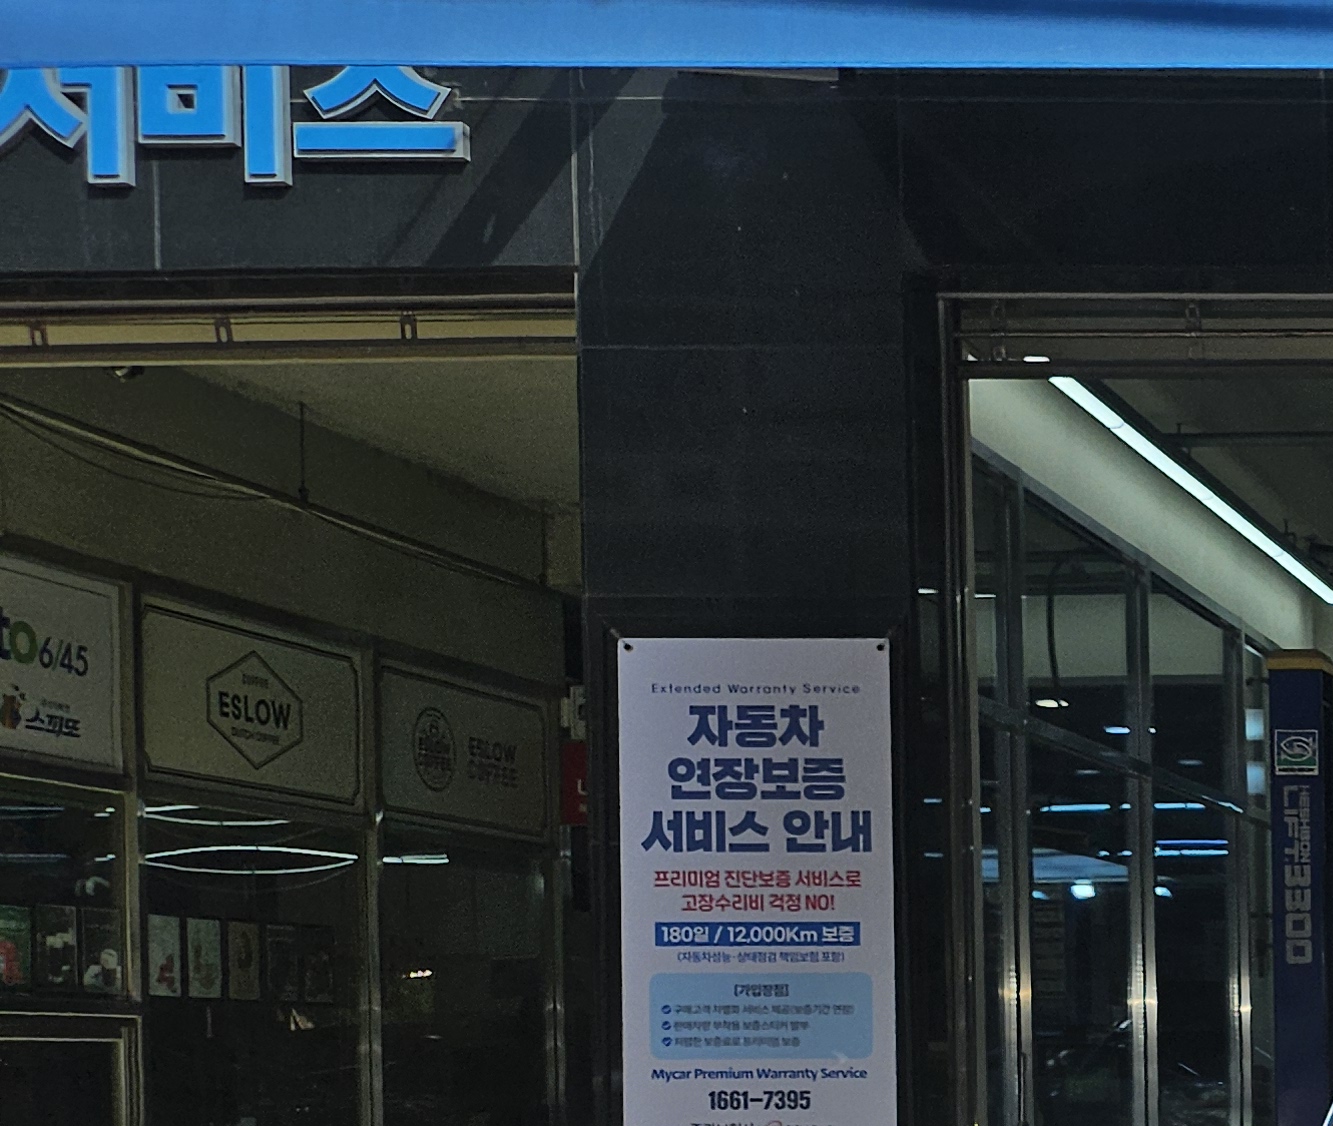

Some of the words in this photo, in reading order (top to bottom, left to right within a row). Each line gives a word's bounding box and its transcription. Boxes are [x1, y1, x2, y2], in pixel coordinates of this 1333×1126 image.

[652, 684, 721, 693] Extended
[728, 684, 796, 695] Warranty
[803, 683, 860, 694] Service
[218, 691, 291, 730] ESLOW
[687, 704, 824, 747] 자동차
[668, 757, 846, 800] 연장보증
[641, 810, 770, 852] 서비스
[783, 810, 872, 853] 안내
[654, 870, 720, 888] 프리미엄
[725, 870, 791, 888] 진단보증
[795, 870, 861, 887] 서비스로
[681, 894, 764, 912] 고장수리비
[769, 894, 801, 912] 걱정
[805, 894, 834, 911] NO!
[1285, 865, 1313, 964] 3300
[661, 926, 709, 942] 180일
[727, 926, 817, 943] 12,000Km
[822, 926, 854, 942] 보증
[651, 1069, 692, 1082] Mycar
[694, 1067, 754, 1079] Premium
[756, 1068, 818, 1081] Warranty
[821, 1067, 867, 1078] Service
[708, 1090, 811, 1110] 1661-7395
